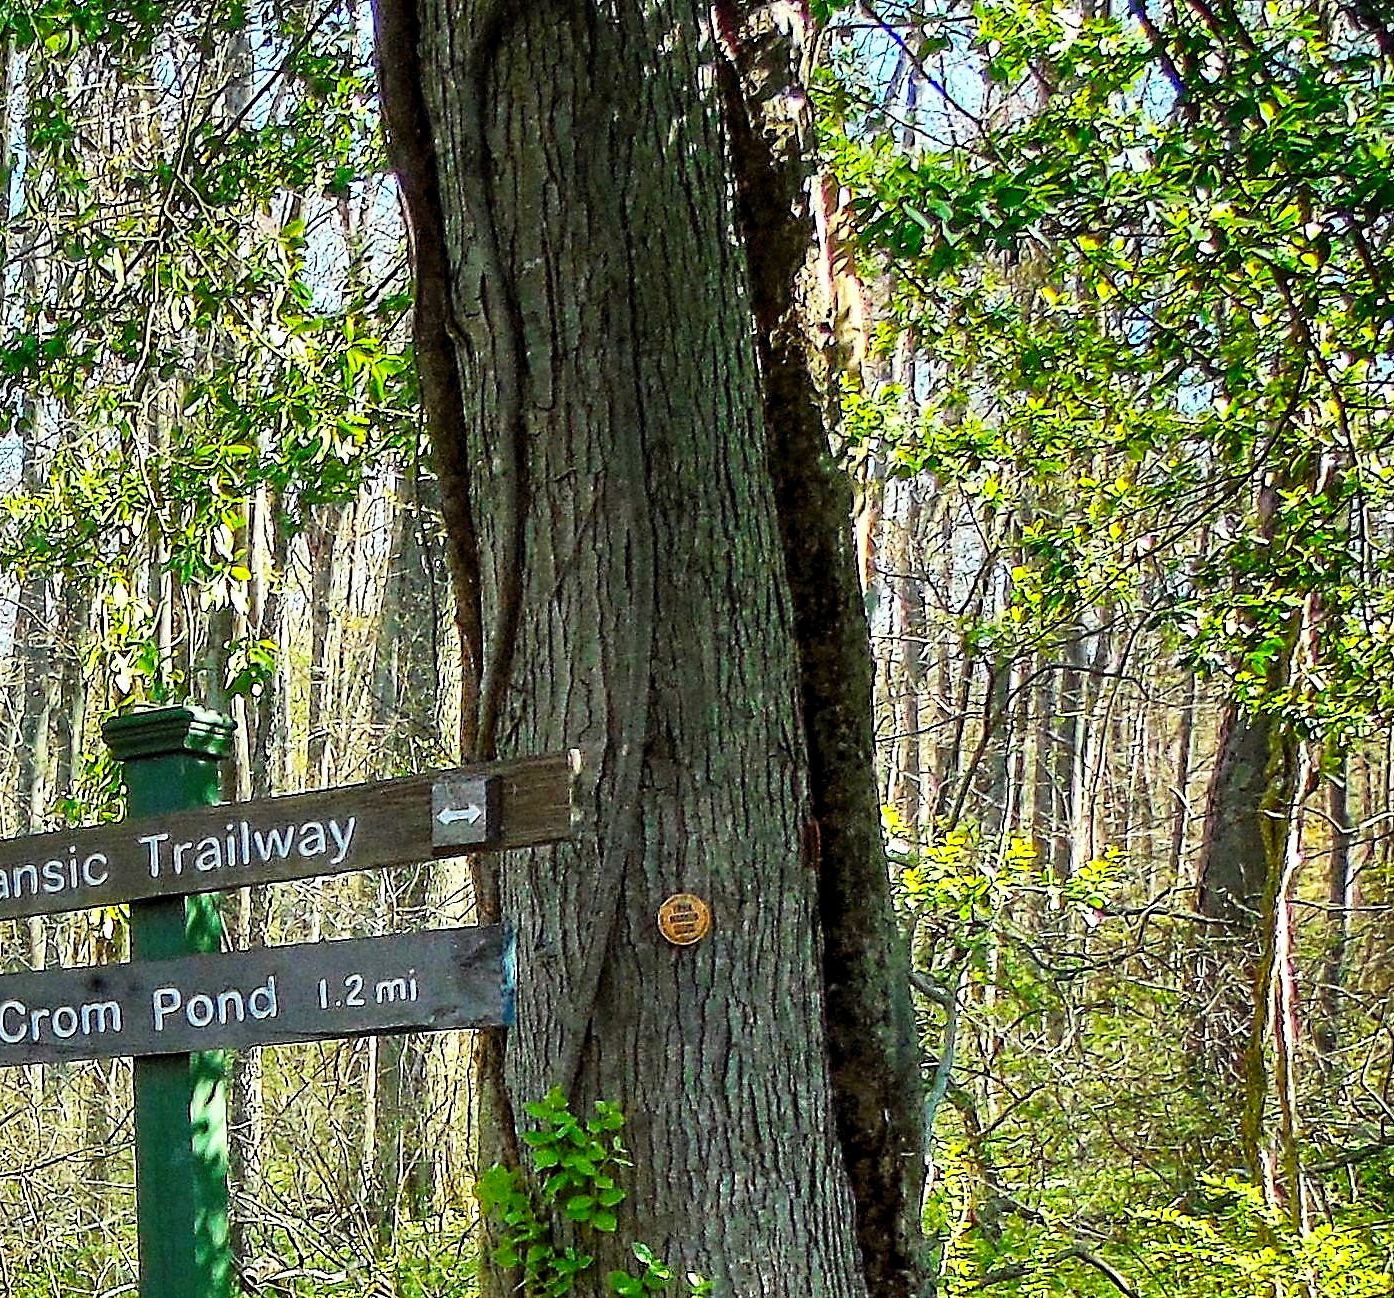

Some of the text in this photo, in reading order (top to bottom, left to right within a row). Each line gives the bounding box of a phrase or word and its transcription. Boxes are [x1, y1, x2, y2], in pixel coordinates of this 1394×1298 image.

[139, 815, 357, 879] Trailway
[154, 976, 278, 1032] Pond
[317, 973, 367, 1010] 1.2
[375, 970, 420, 1005] mi
